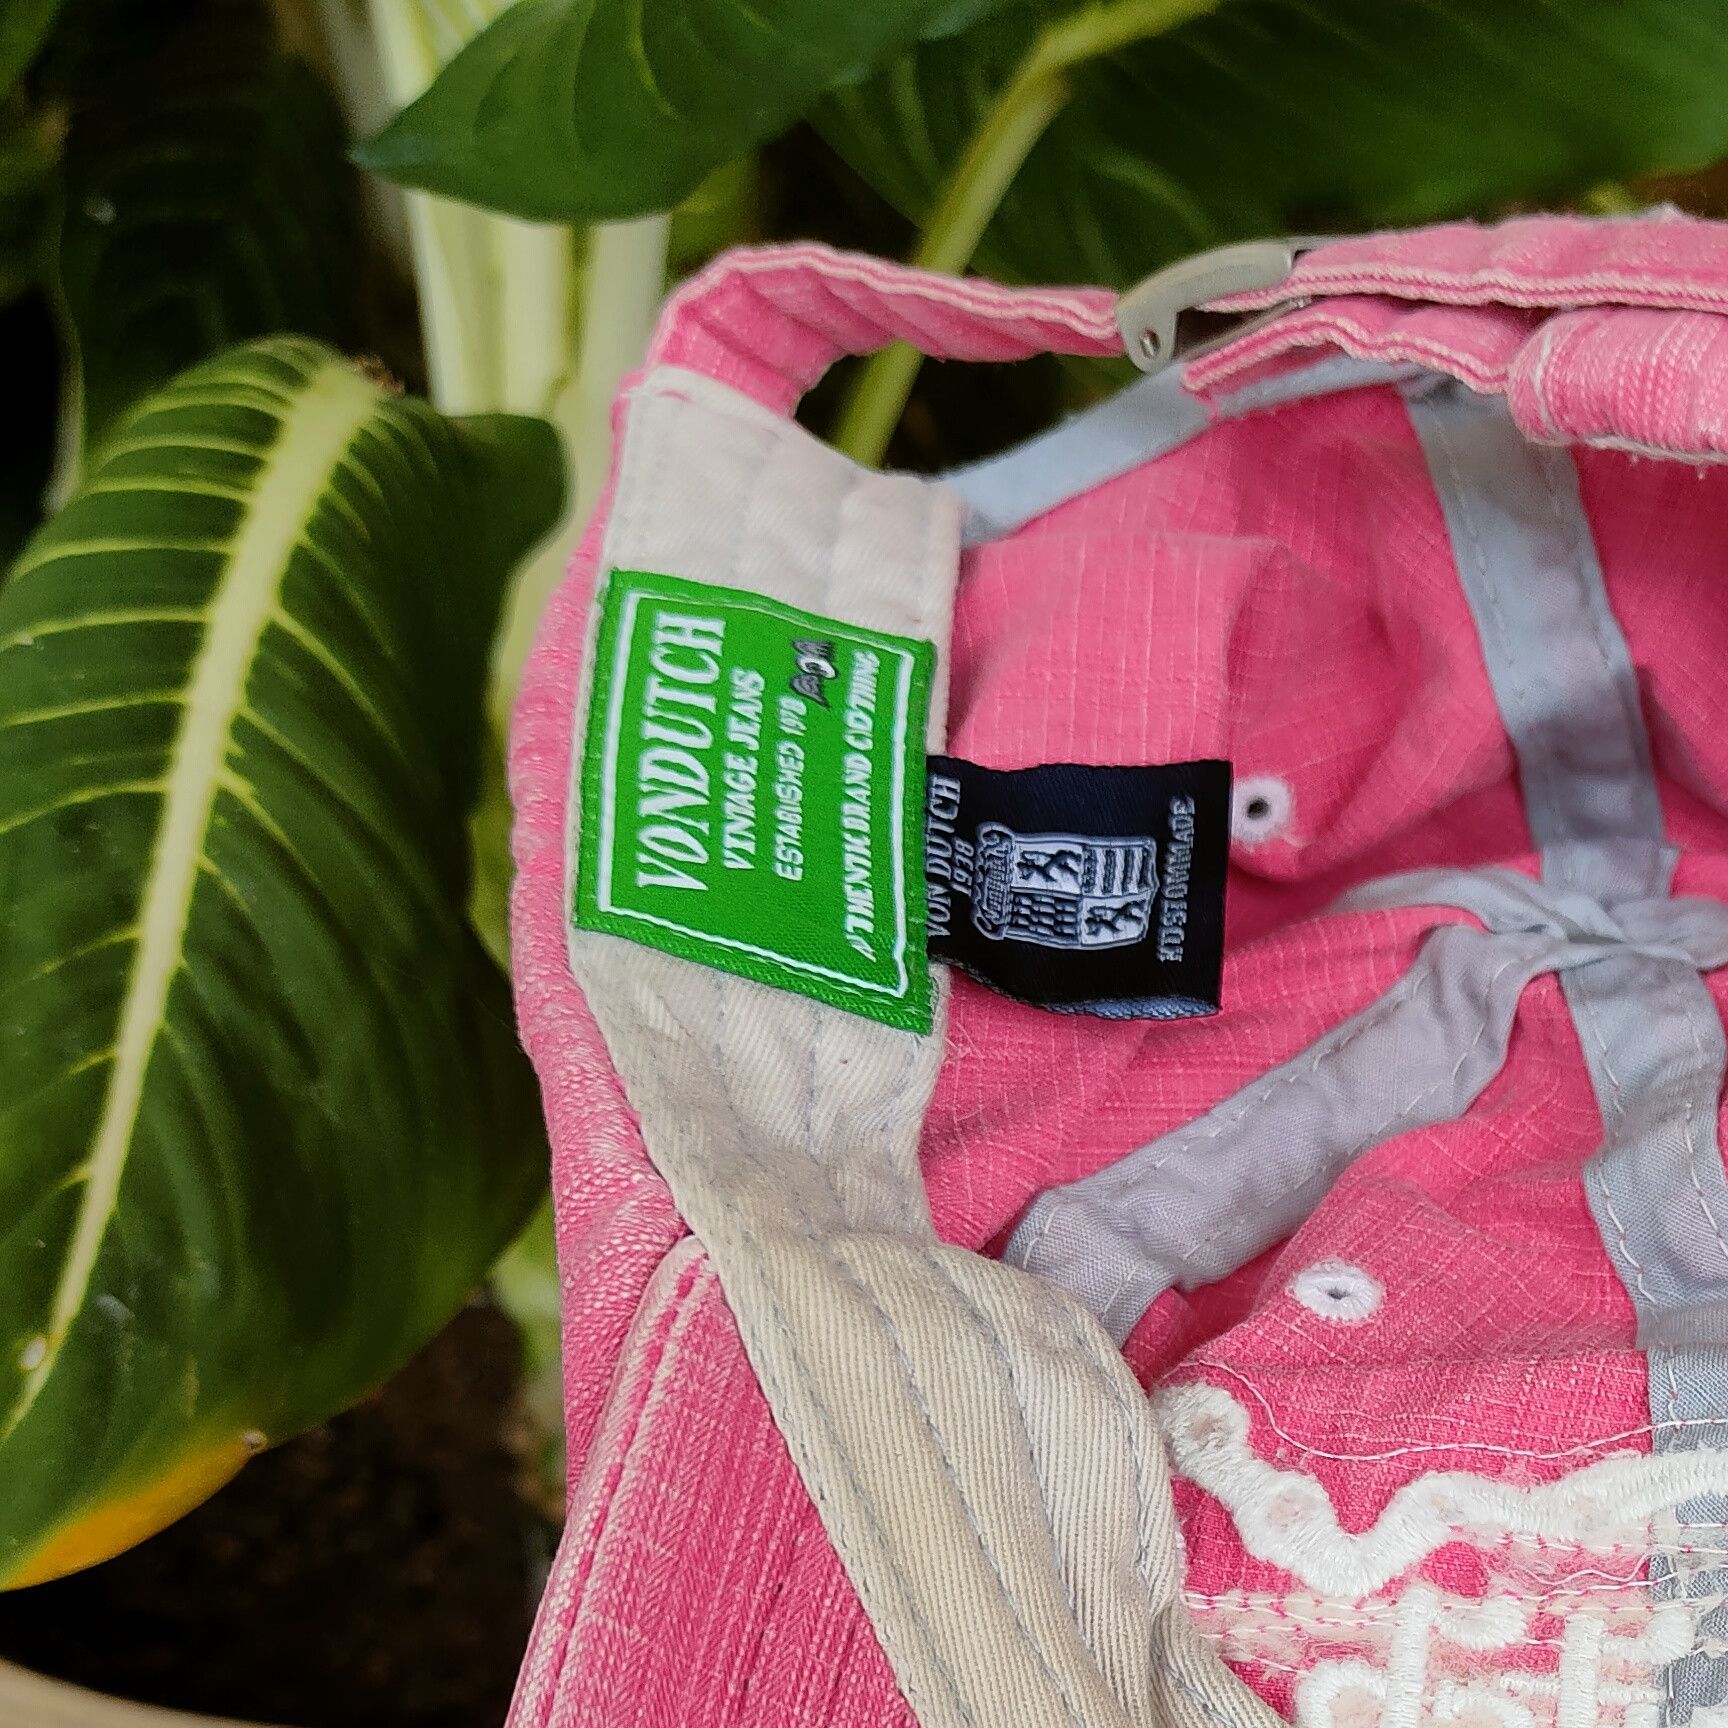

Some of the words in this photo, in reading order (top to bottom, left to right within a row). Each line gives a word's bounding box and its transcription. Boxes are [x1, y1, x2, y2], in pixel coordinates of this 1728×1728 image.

[636, 611, 727, 892] VONDUTCH
[727, 666, 766, 751] JEANS
[722, 752, 759, 870] VINTAGE
[775, 740, 805, 881] ESTABLISHED
[841, 752, 873, 832] BRAND
[927, 772, 961, 880] DUTCH
[927, 882, 951, 939] VON
[951, 834, 975, 898] 1938
